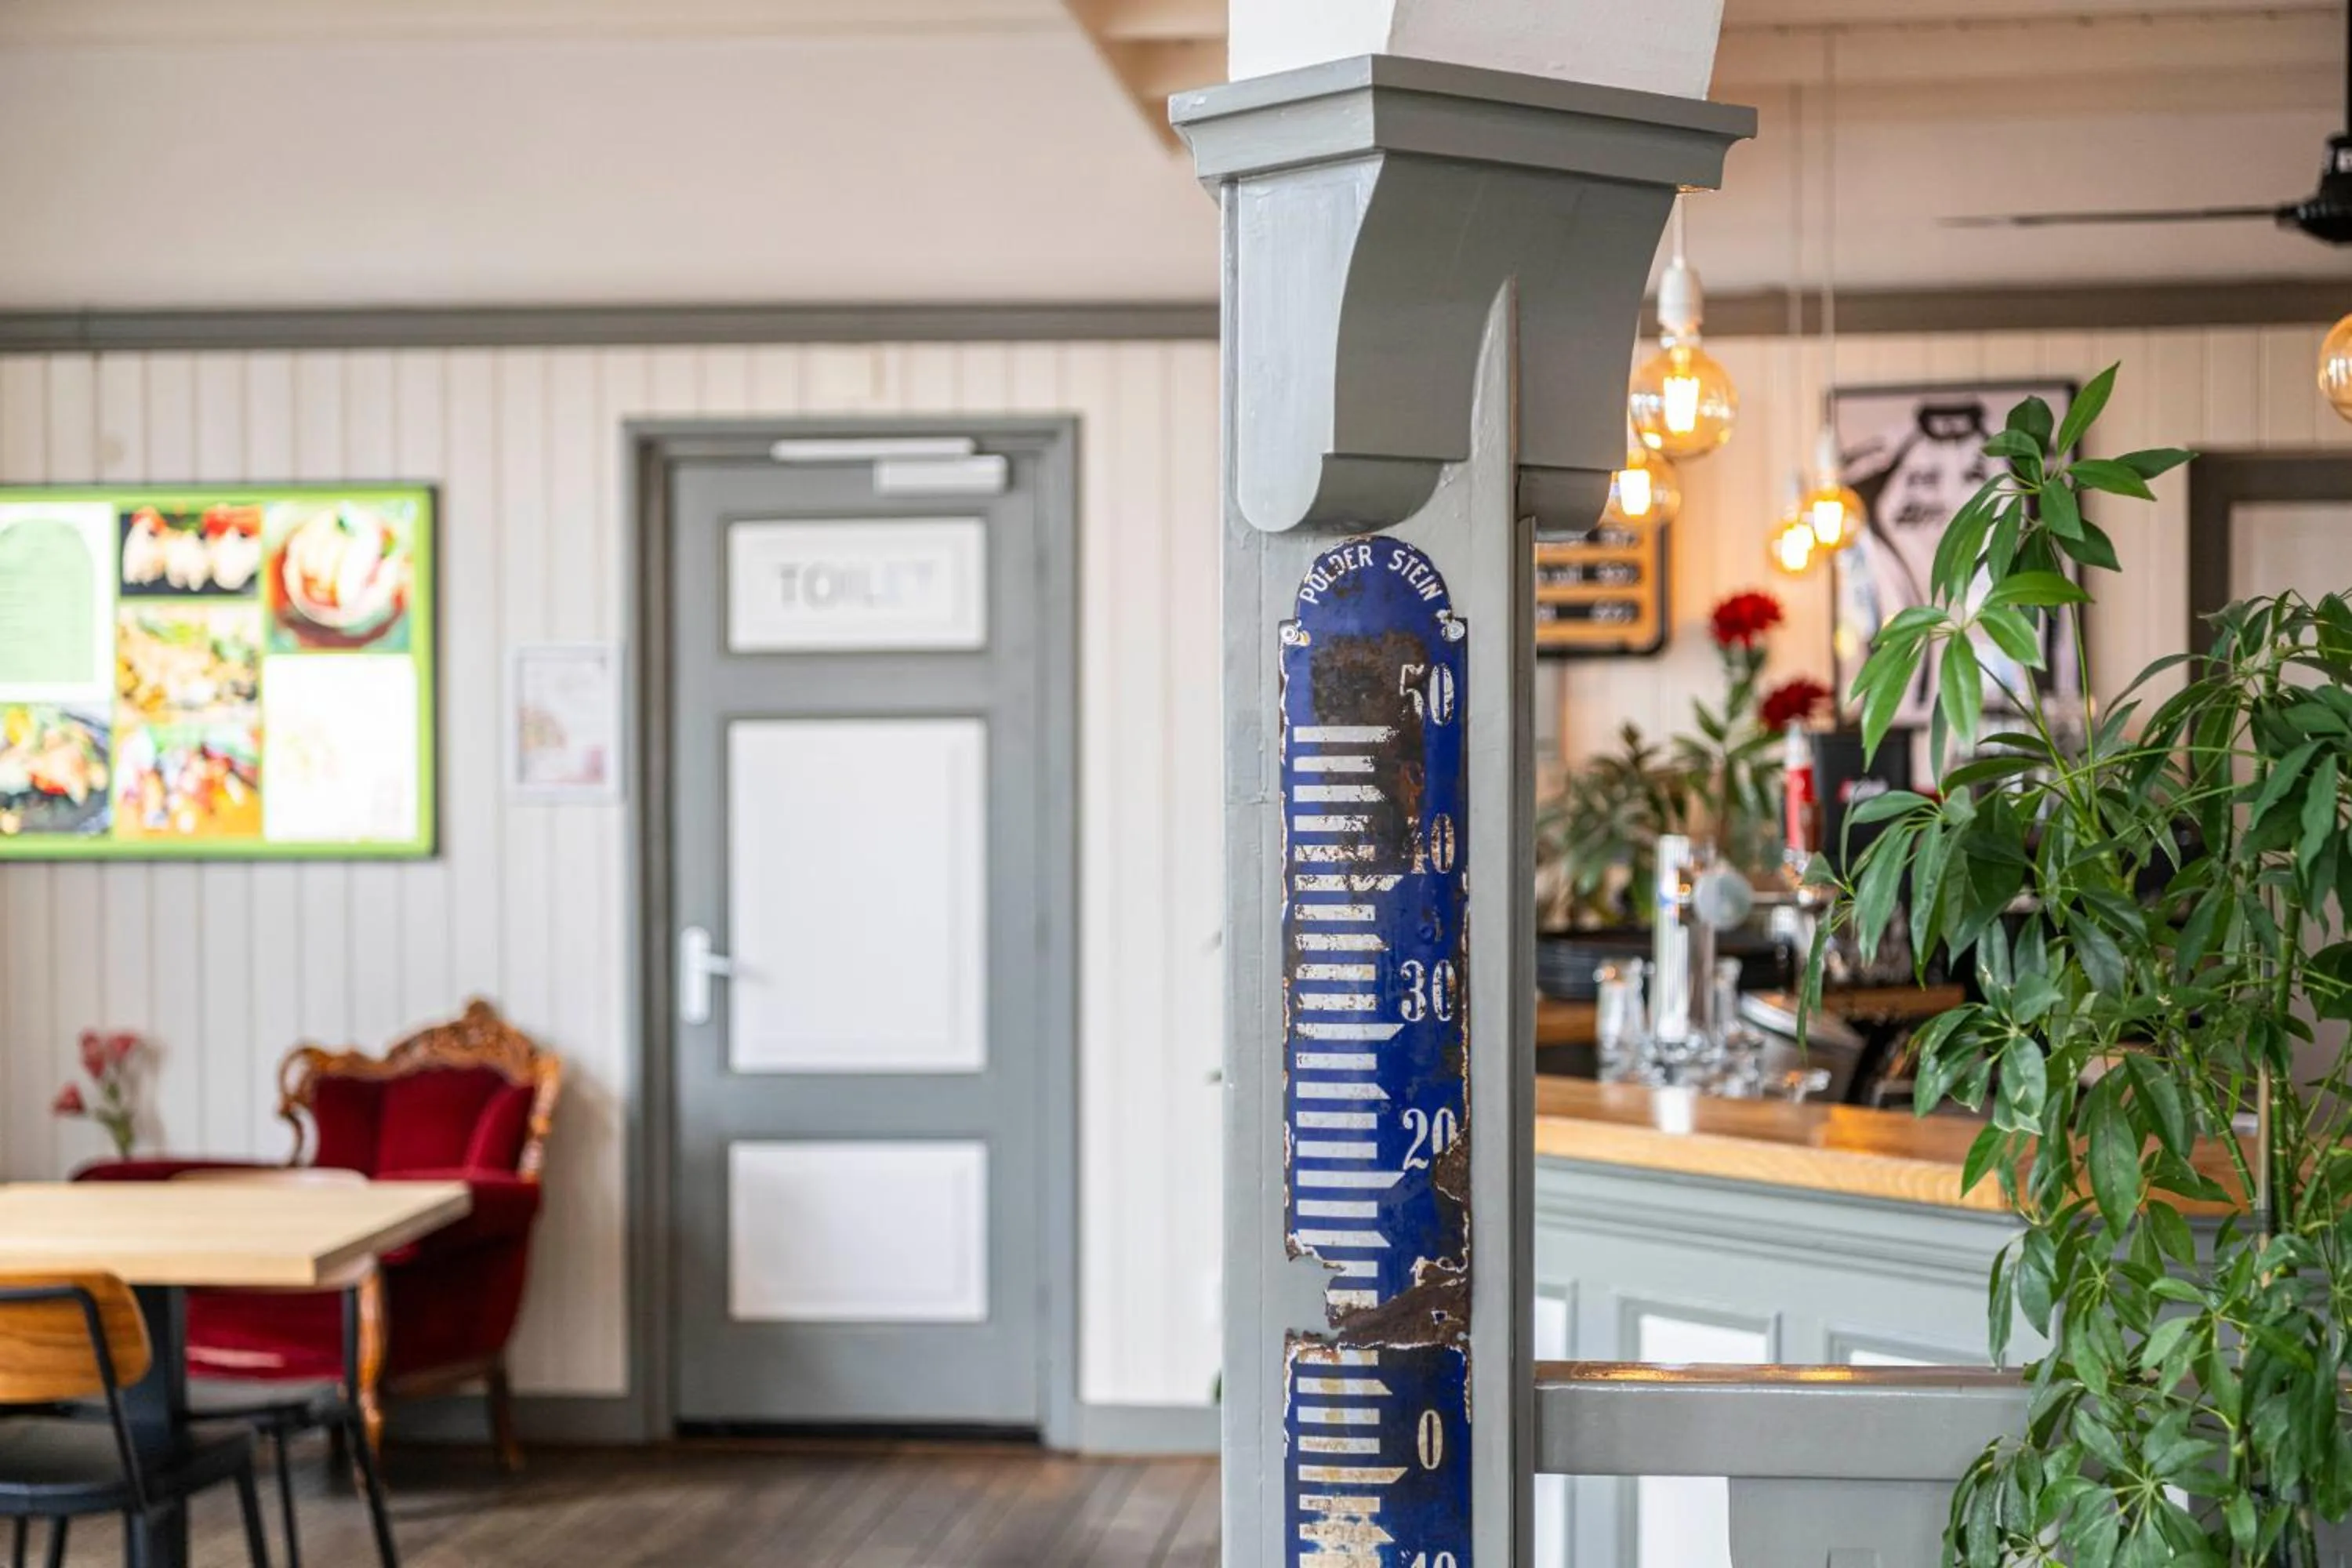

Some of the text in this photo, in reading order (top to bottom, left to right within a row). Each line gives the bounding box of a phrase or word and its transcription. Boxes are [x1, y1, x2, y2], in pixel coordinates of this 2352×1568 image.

[1299, 545, 1443, 604] POLDER STEIN
[1399, 662, 1454, 727] 50
[1400, 960, 1456, 1022] 30
[1403, 1107, 1457, 1171] 20
[1417, 1410, 1443, 1470] 0
